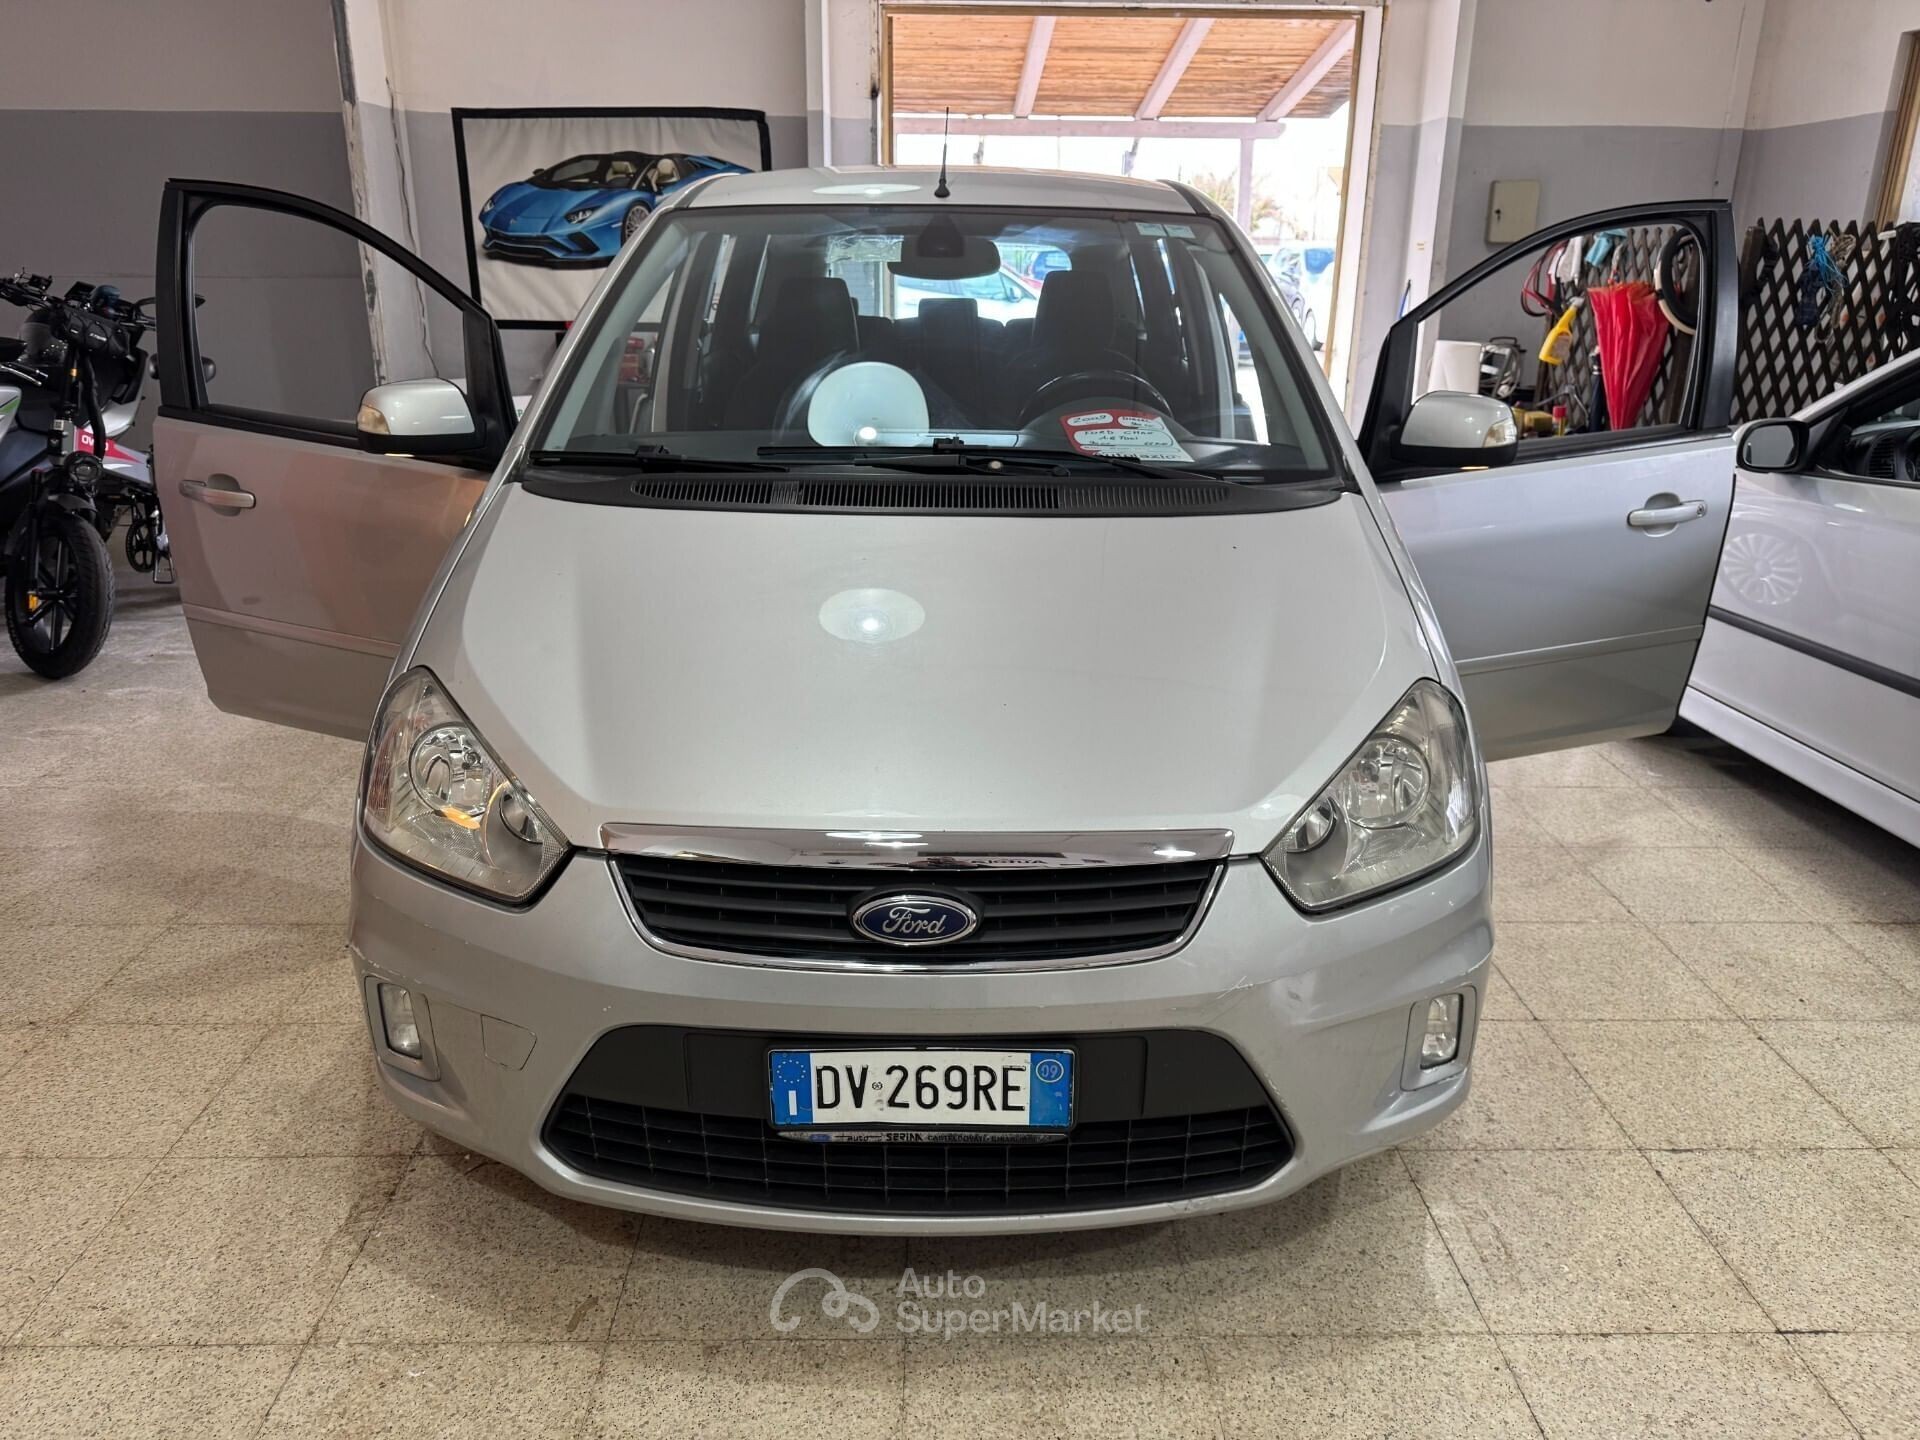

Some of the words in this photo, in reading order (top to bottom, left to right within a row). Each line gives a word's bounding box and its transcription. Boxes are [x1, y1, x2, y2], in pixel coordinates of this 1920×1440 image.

[882, 906, 947, 934] Ford
[815, 1065, 869, 1110] DV
[886, 1065, 1027, 1111] 269RE
